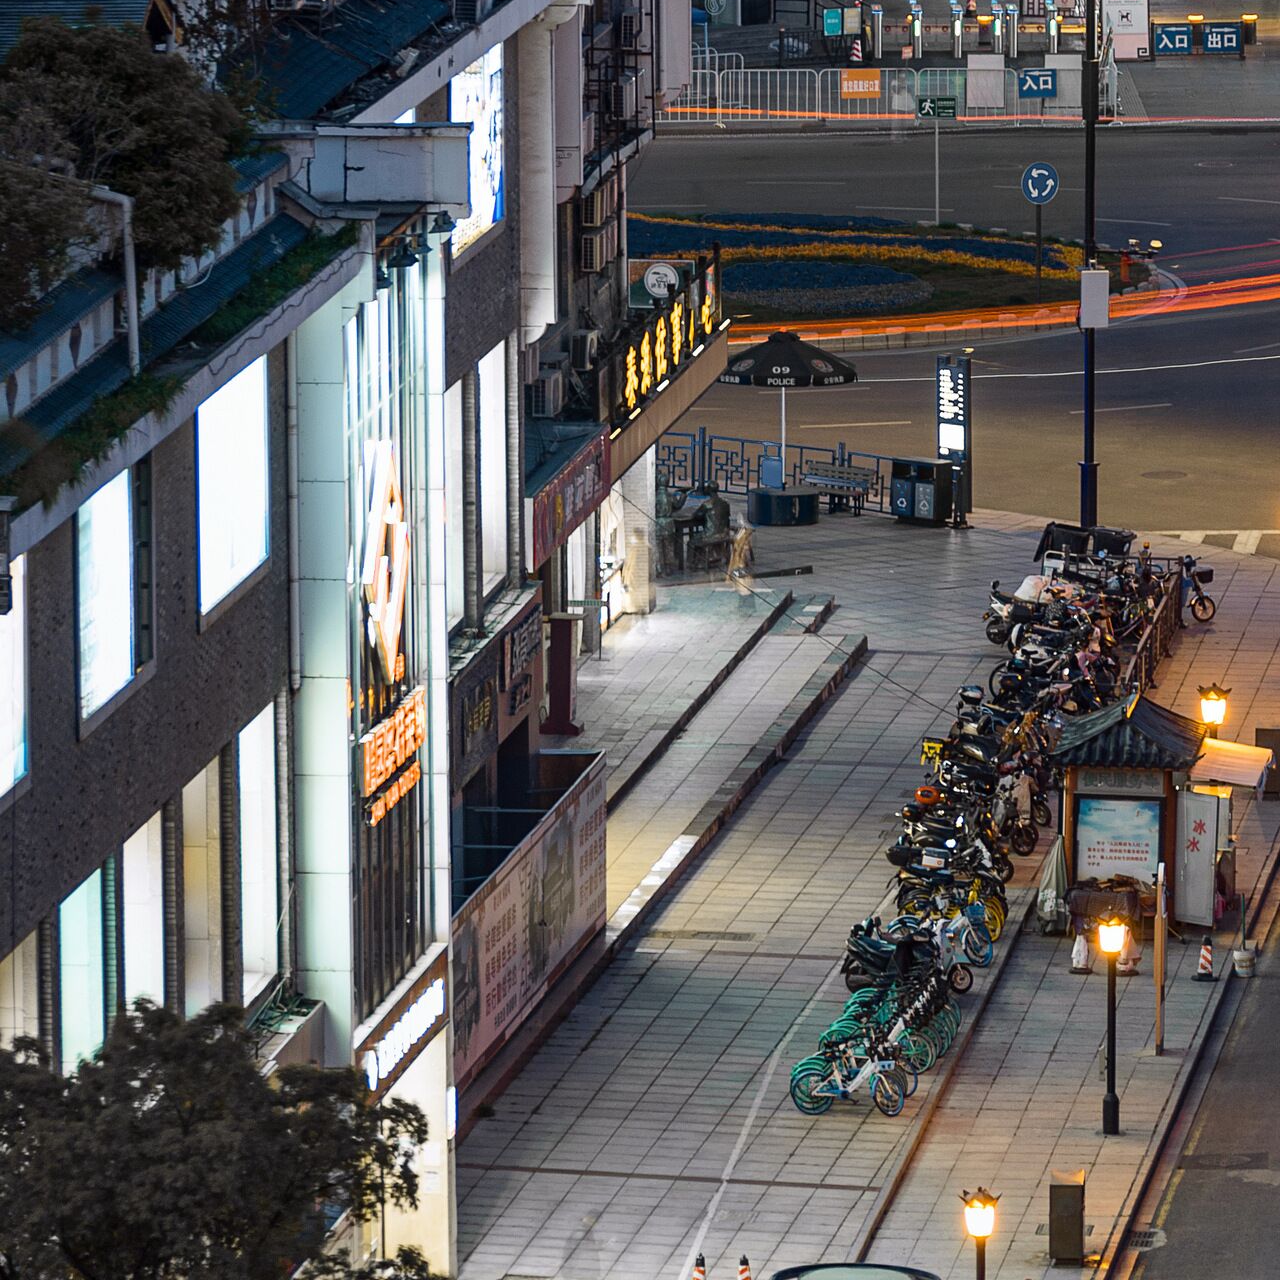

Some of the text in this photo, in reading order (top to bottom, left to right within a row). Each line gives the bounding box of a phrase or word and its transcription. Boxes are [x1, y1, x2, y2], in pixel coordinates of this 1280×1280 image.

[1158, 34, 1188, 49] 入口
[1207, 33, 1237, 49] 出口
[1022, 76, 1053, 91] 入口
[772, 366, 790, 374] 09
[767, 377, 796, 386] POLICE
